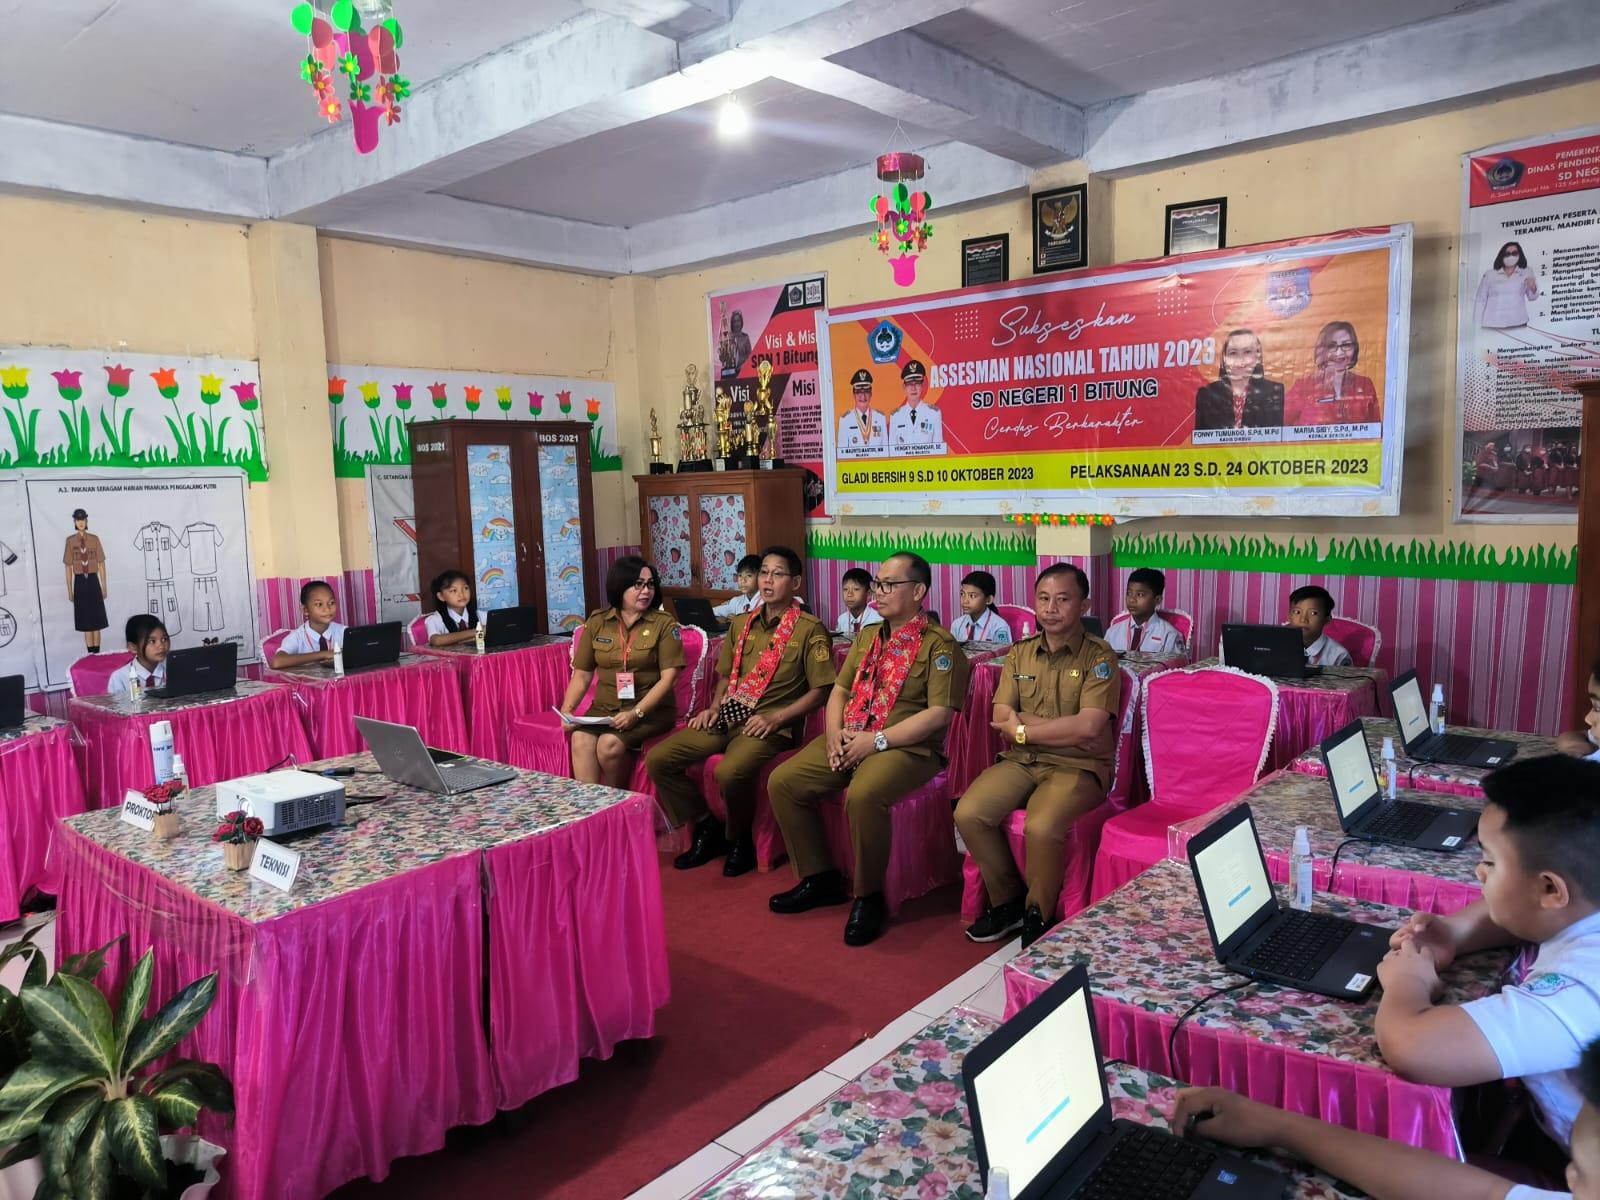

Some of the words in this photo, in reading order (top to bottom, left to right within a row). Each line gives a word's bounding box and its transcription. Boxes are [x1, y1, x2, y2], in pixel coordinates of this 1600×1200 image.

[1556, 146, 1600, 160] PEMERINT
[1527, 164, 1555, 174] DINAS
[1558, 172, 1572, 181] SD
[1501, 214, 1560, 228] TERWUJUDNYA
[1562, 208, 1597, 219] PESERTA
[1514, 225, 1555, 236] TERAMPIL,
[1557, 219, 1595, 229] MANDIRI
[765, 333, 782, 350] Visi
[786, 331, 795, 346] &
[798, 329, 817, 345] Mis
[776, 352, 780, 365] 1
[929, 357, 1010, 388] ASSESMAN
[1013, 349, 1095, 379] NASIONAL
[1099, 342, 1159, 373] TAHUN
[1164, 337, 1215, 368] 2023
[730, 385, 750, 402] Visi
[792, 379, 815, 396] Misi
[972, 392, 994, 409] SD
[998, 387, 1064, 408] NEGERI
[1070, 385, 1078, 402] 1
[1085, 378, 1158, 401] BITUNG
[984, 416, 1040, 440] Cerdas
[1043, 406, 1143, 438] Berkarakter
[559, 434, 578, 442] 2021
[842, 472, 869, 484] GLADI
[872, 471, 906, 483] BERSIH
[909, 471, 915, 482] 9
[917, 470, 934, 482] S.D
[938, 470, 948, 481] 10
[950, 468, 1004, 482] OKTOBER
[1008, 467, 1034, 480] 2023
[1070, 463, 1170, 479] PELAKSANAAN
[1174, 462, 1189, 477] 23
[1194, 461, 1221, 476] S.D.
[1226, 461, 1242, 475] 24
[1247, 459, 1325, 475] OKTOBER
[1331, 458, 1368, 474] 2023
[260, 853, 290, 878] TEKNISI
